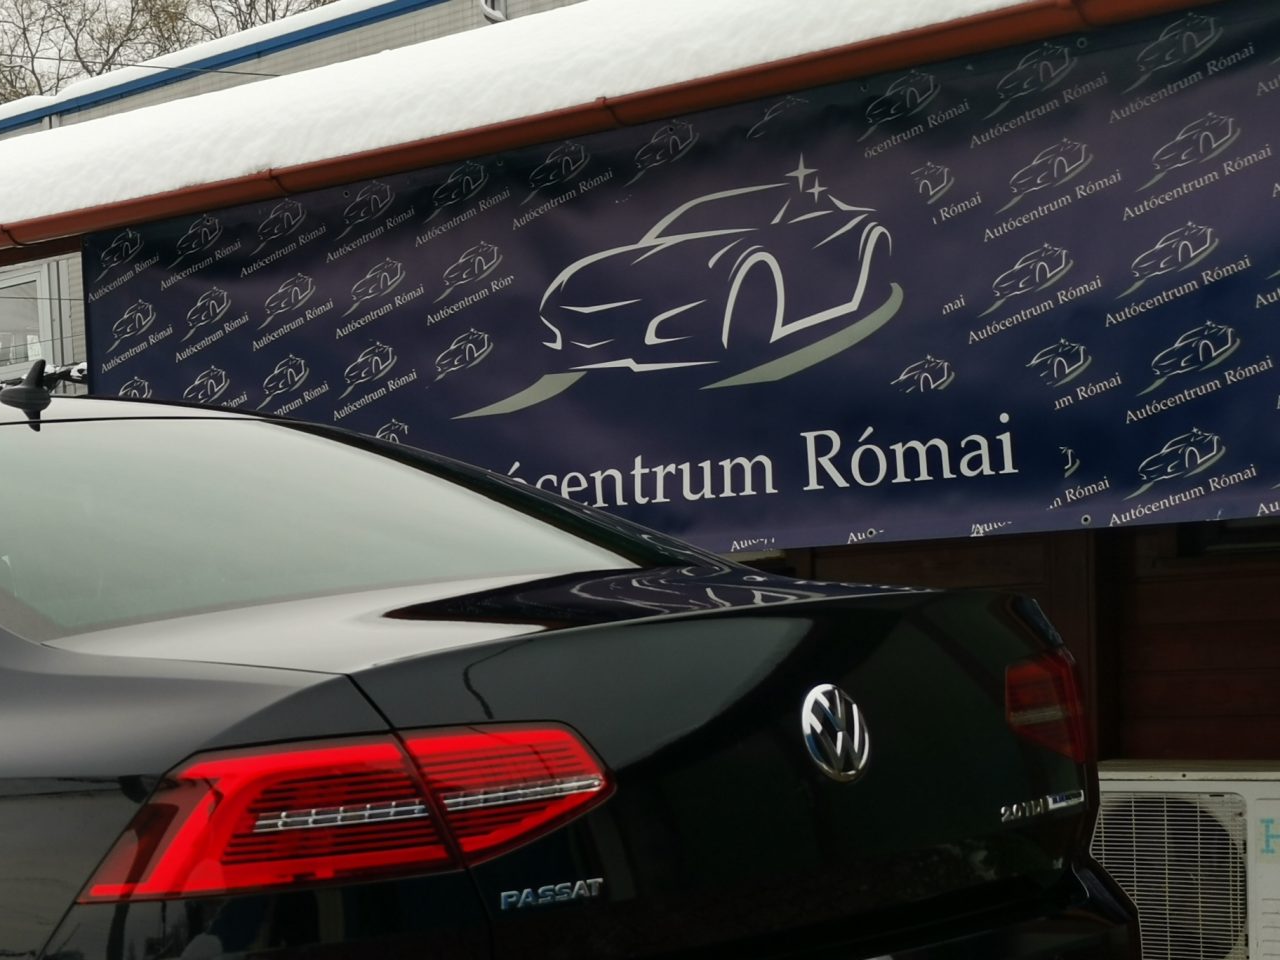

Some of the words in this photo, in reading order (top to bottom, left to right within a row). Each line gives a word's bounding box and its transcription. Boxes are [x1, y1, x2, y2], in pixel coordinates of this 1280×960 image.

[1109, 71, 1203, 124] Autócentrum
[1206, 42, 1255, 75] Római
[927, 99, 970, 128] Római
[970, 98, 1060, 149] Autócentrum
[1062, 72, 1108, 105] Római
[512, 191, 577, 230] Autócentrum
[578, 168, 614, 192] Római
[939, 192, 982, 221] Római
[984, 194, 1072, 242] Autócentrum
[1075, 168, 1122, 199] Római
[1123, 170, 1219, 221] Autócentrum
[1223, 144, 1272, 176] Római
[325, 228, 385, 263] Autócentrum
[386, 206, 415, 228] Római
[415, 208, 477, 247] Autócentrum
[479, 187, 511, 210] Római
[160, 256, 213, 291] Autócentrum
[215, 240, 242, 261] Római
[240, 242, 297, 278] Autócentrum
[298, 224, 327, 247] Római
[88, 269, 134, 303] Autócentrum
[134, 254, 160, 274] Római
[1105, 280, 1199, 327] Autócentrum
[1201, 254, 1252, 285] Római
[252, 318, 304, 352] Autócentrum
[305, 299, 335, 321] Római
[335, 304, 394, 339] Autócentrum
[394, 285, 425, 307] Római
[426, 288, 490, 326] Autócentrum
[968, 299, 1055, 345] Autócentrum
[1057, 275, 1102, 305] Római
[101, 340, 148, 373] Autócentrum
[149, 325, 173, 345] Római
[175, 329, 223, 363] Autócentrum
[224, 314, 249, 334] Római
[303, 381, 329, 402] Római
[333, 389, 387, 422] Autócentrum
[387, 369, 418, 392] Római
[1076, 372, 1122, 401] Római
[1126, 379, 1222, 424] Autócentrum
[1224, 355, 1274, 386] Római
[800, 413, 1019, 490] Római
[1065, 476, 1110, 502] Római
[1109, 485, 1205, 527] Autócentrum
[1209, 464, 1257, 492] Római
[501, 878, 603, 910] PASSAT
